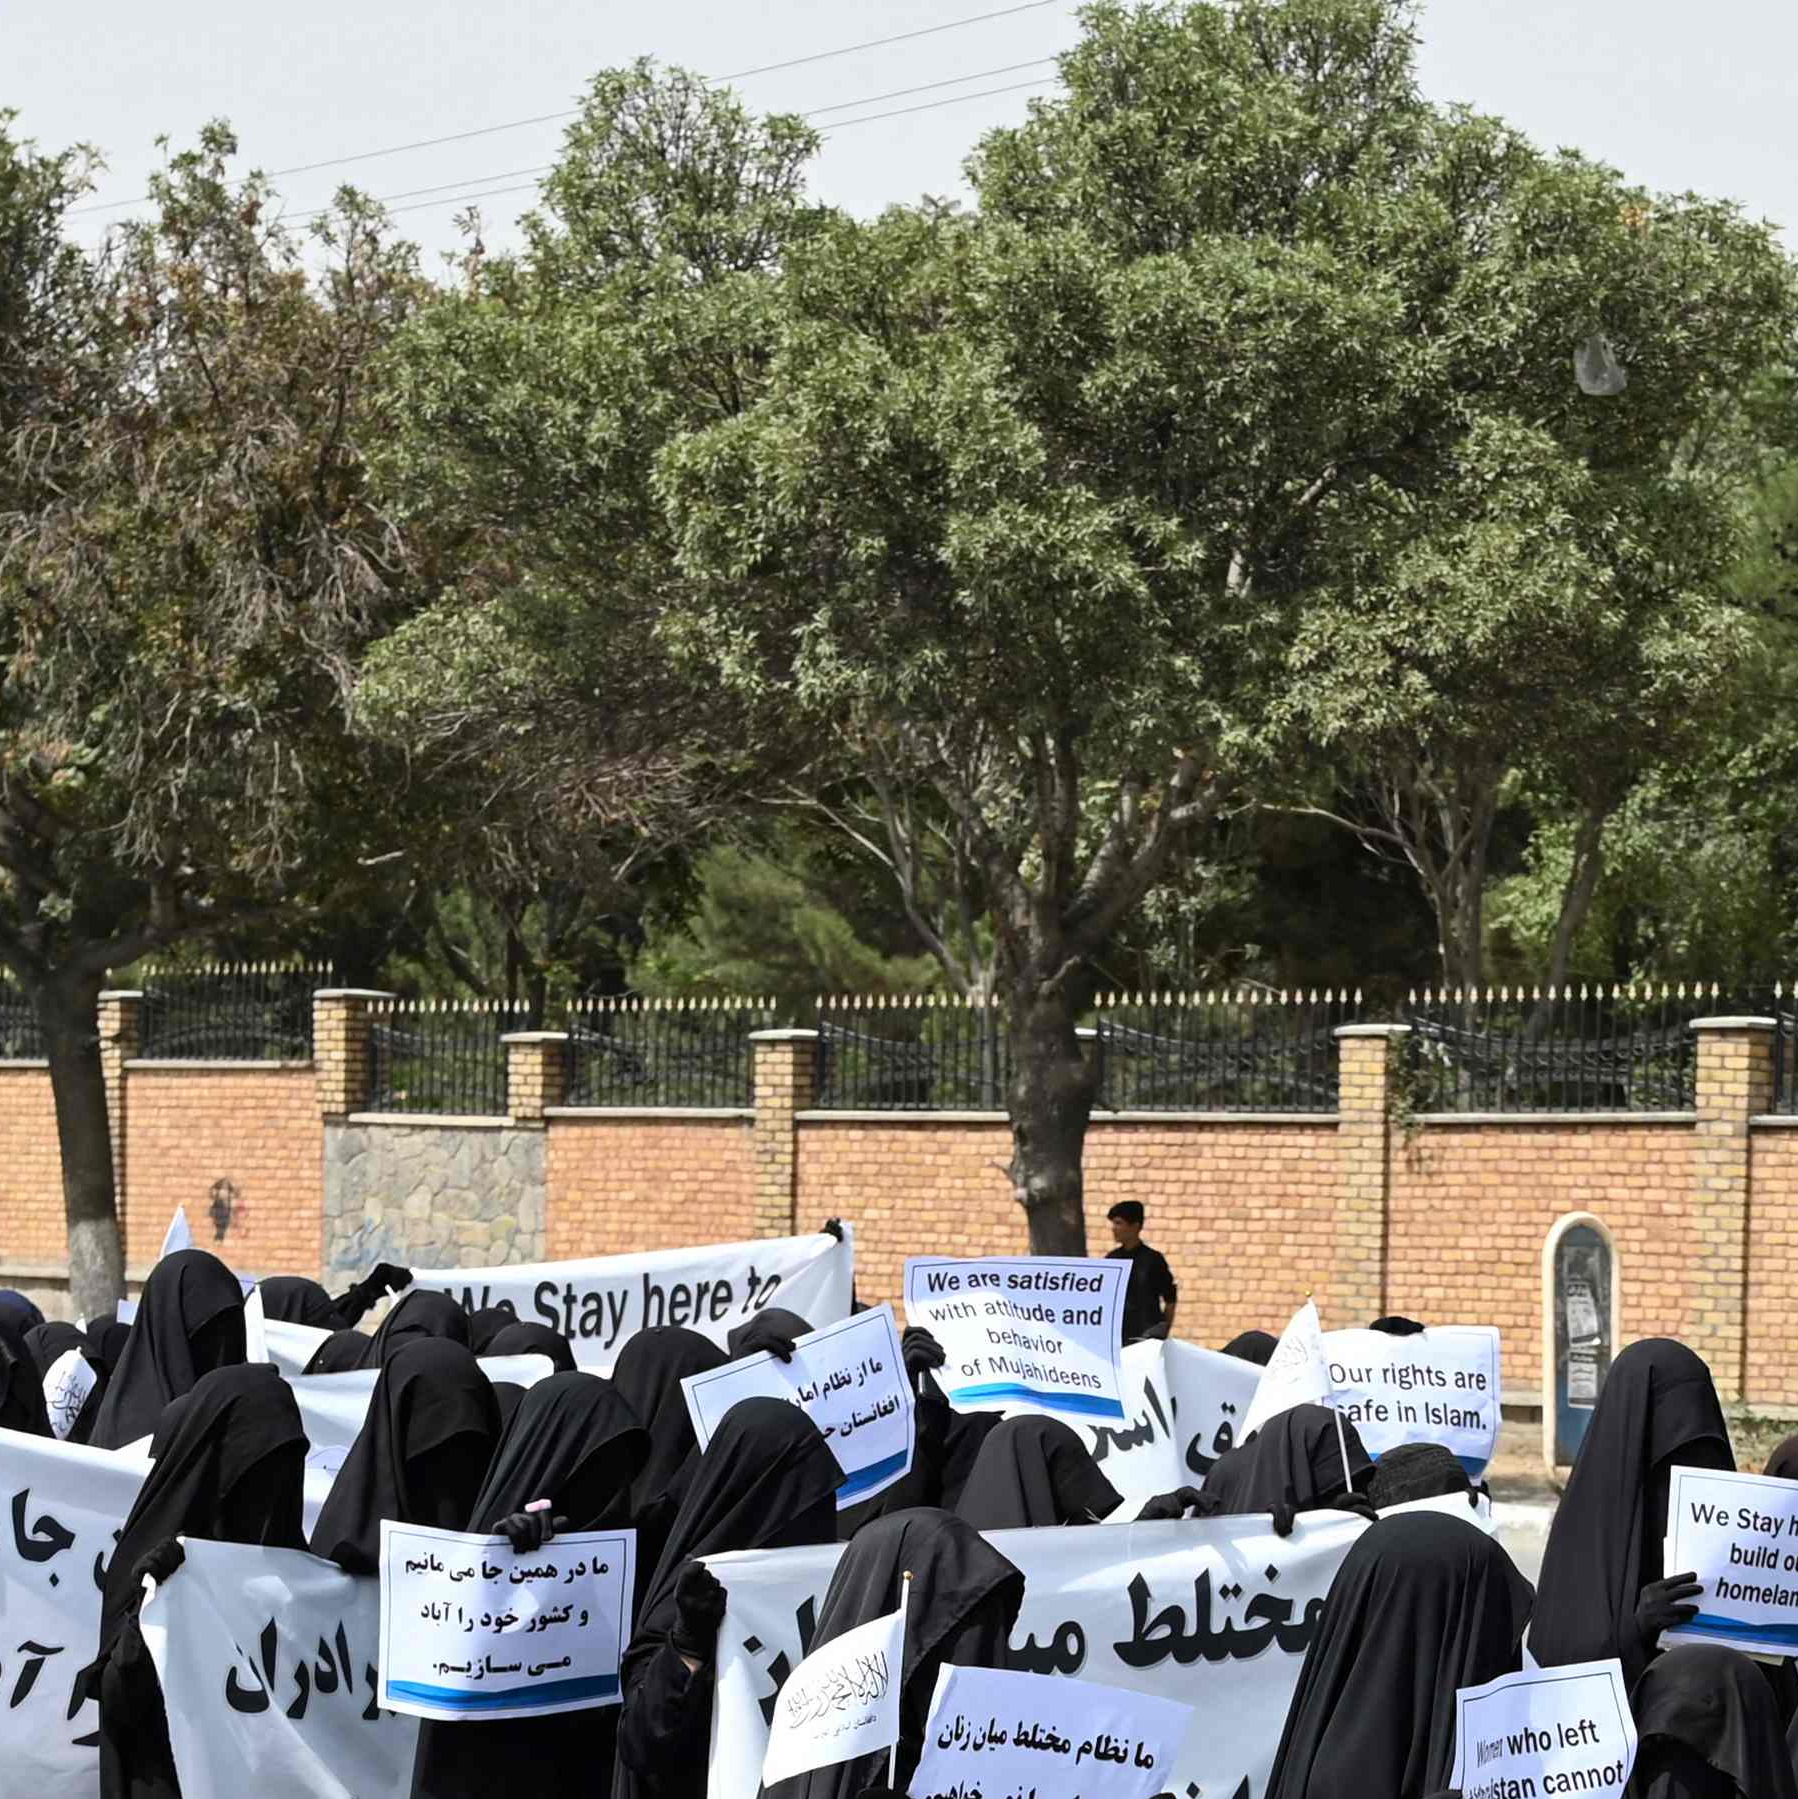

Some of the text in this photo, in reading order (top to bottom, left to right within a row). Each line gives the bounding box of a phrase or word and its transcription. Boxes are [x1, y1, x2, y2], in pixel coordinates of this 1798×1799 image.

[928, 1272, 1104, 1293] We are satisfied
[533, 1280, 629, 1350] Stay
[642, 1273, 733, 1327] here
[741, 1265, 783, 1315] to
[929, 1299, 1103, 1326] with attitude and
[986, 1327, 1063, 1355] behavior
[856, 1361, 869, 1387] از
[869, 1358, 883, 1374] ما
[960, 1356, 1103, 1390] of Mujahideens
[1330, 1363, 1487, 1391] Our rights are
[822, 1368, 853, 1401] نظام
[840, 1394, 901, 1437] افغانستان
[1397, 1400, 1417, 1424] in
[1425, 1402, 1488, 1431] Islam.
[1690, 1502, 1730, 1527] We
[1736, 1507, 1785, 1539] Stay
[12, 1487, 76, 1588] جا
[405, 1552, 610, 1585] ما در همین جا می مانیم
[1729, 1542, 1780, 1570] build
[420, 1602, 589, 1634] و کشور خود را آباد
[225, 1615, 399, 1721] رادران
[937, 1714, 1154, 1770] ما نظام مختلط میان زنان
[1506, 1726, 1552, 1756] who
[1557, 1719, 1600, 1749] left
[1543, 1759, 1625, 1796] cannot
